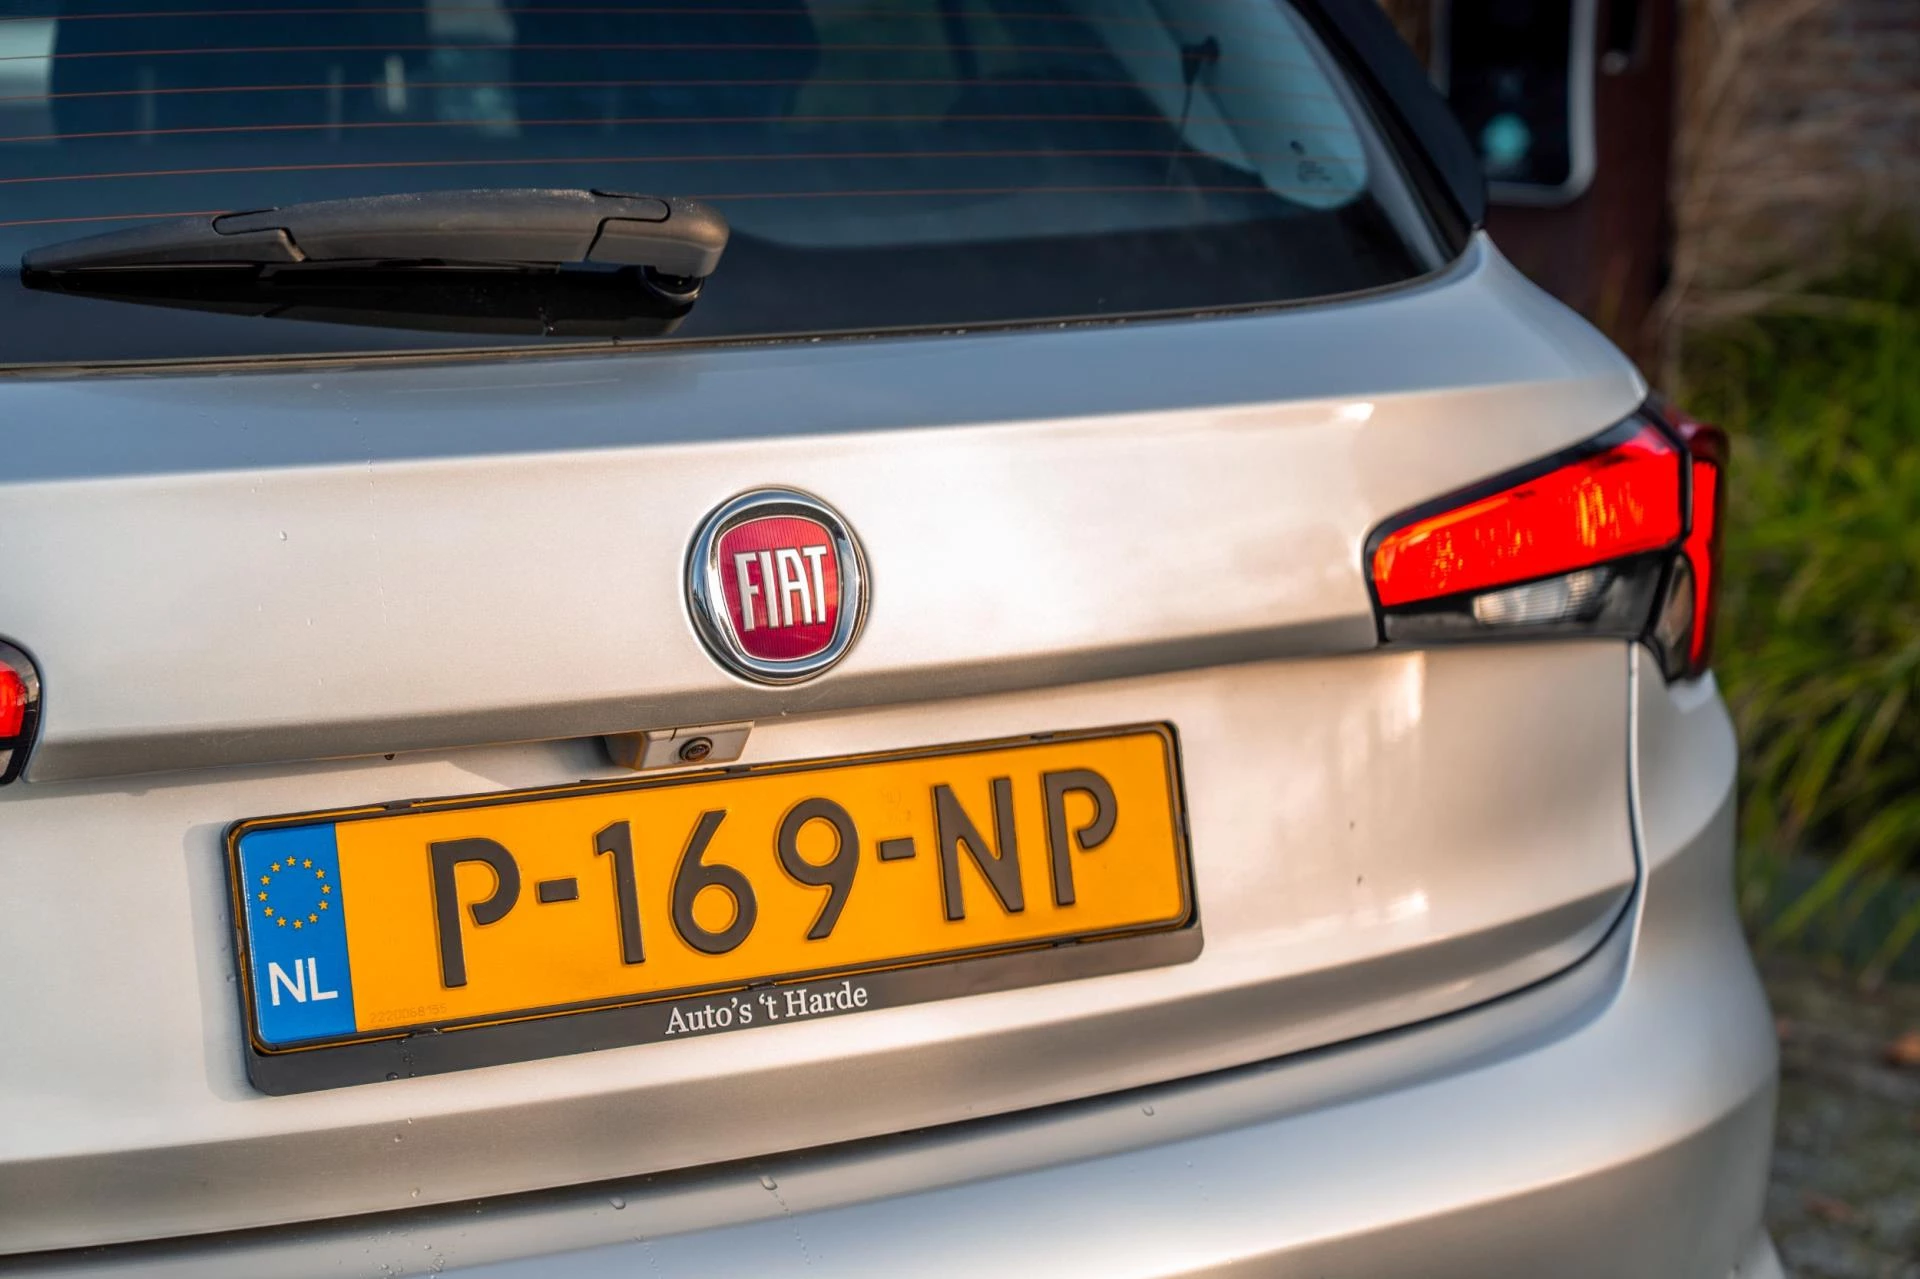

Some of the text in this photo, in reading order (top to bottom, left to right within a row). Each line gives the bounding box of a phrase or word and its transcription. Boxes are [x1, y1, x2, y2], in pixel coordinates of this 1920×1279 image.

[734, 545, 828, 631] FIAT
[428, 767, 1119, 990] P-169-NP
[268, 957, 338, 1006] NL
[664, 997, 753, 1035] Auto’s
[783, 980, 868, 1018] Harde
